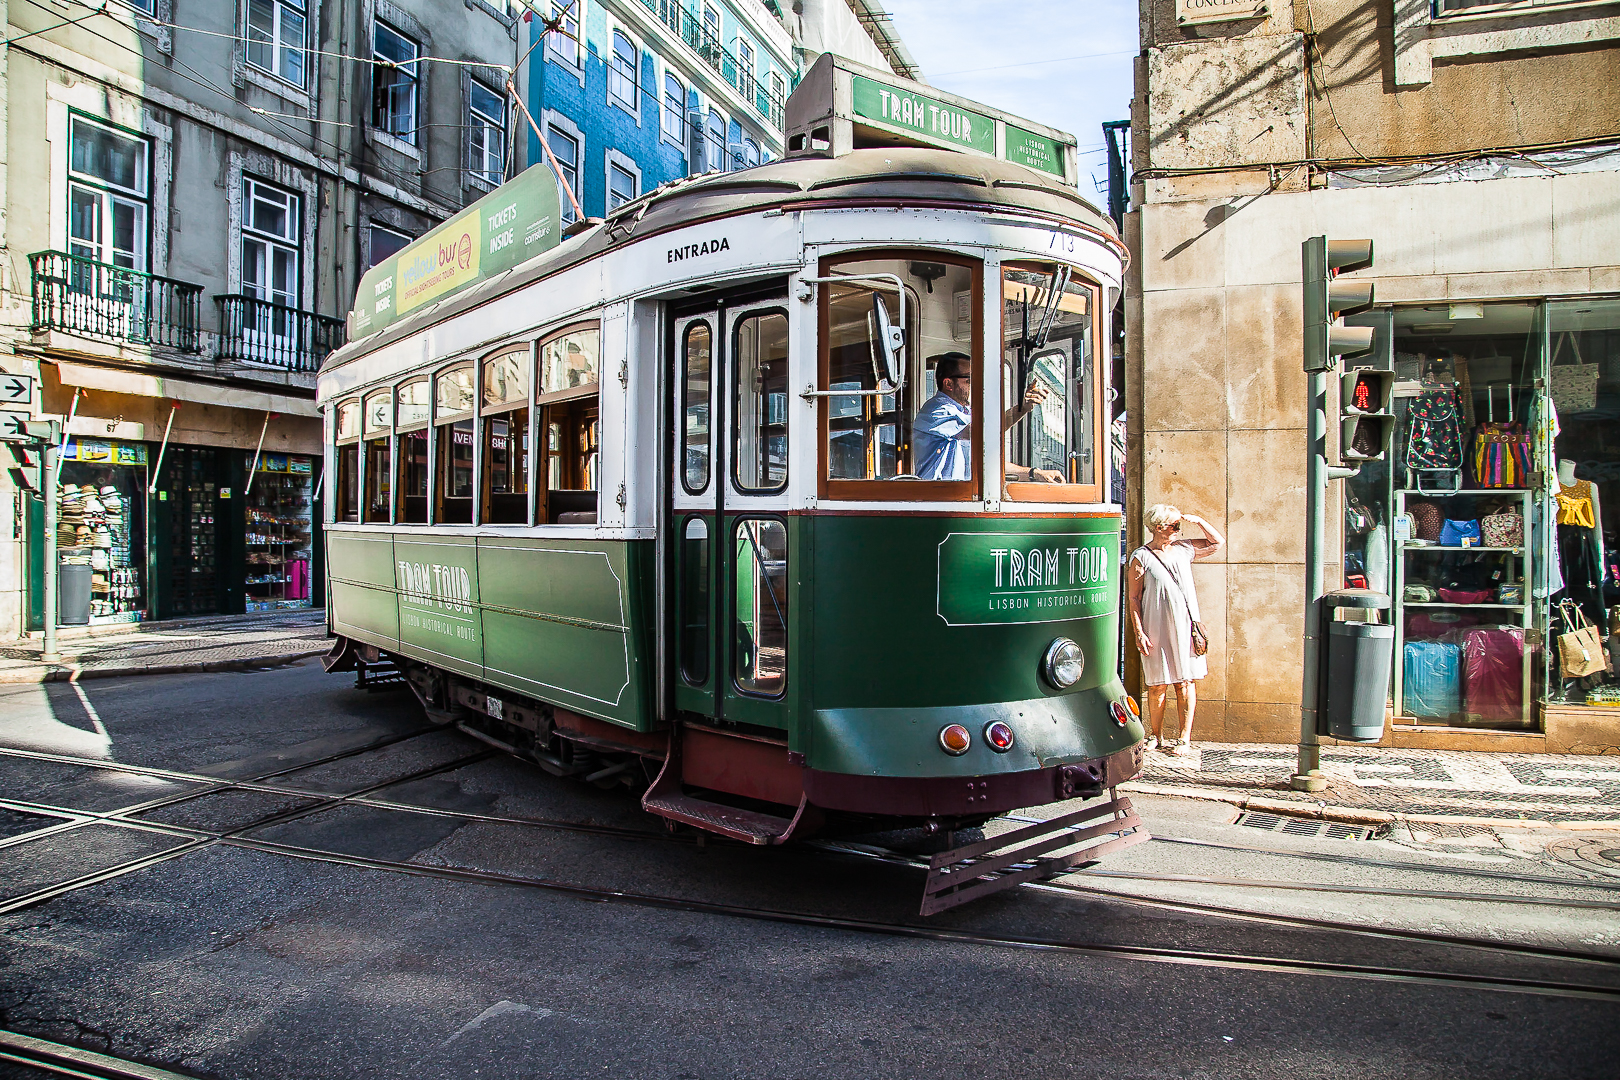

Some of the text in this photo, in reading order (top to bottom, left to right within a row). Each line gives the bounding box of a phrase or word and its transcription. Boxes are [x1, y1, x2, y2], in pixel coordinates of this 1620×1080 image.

[879, 89, 972, 143] TRAM TOUR
[1019, 145, 1050, 161] HISTORICAL
[1025, 138, 1045, 150] LISBON
[1026, 157, 1043, 167] ROUTE
[488, 203, 517, 232] TICKETS
[489, 228, 514, 254] INSIDE
[667, 237, 730, 263] ENTRADA
[1049, 229, 1074, 252] 713
[403, 242, 457, 287] yellow bus
[441, 266, 455, 280] TOURS
[374, 276, 392, 296] TICKETS
[375, 295, 391, 314] INSIDE
[106, 424, 116, 432] 67
[990, 546, 1108, 587] TRAM TOUR
[398, 561, 473, 615] TRAM TOUR
[989, 592, 1108, 610] LISBON HISTORICAL ROUTE
[402, 613, 476, 642] LISBON HISTORICAL ROUTE
